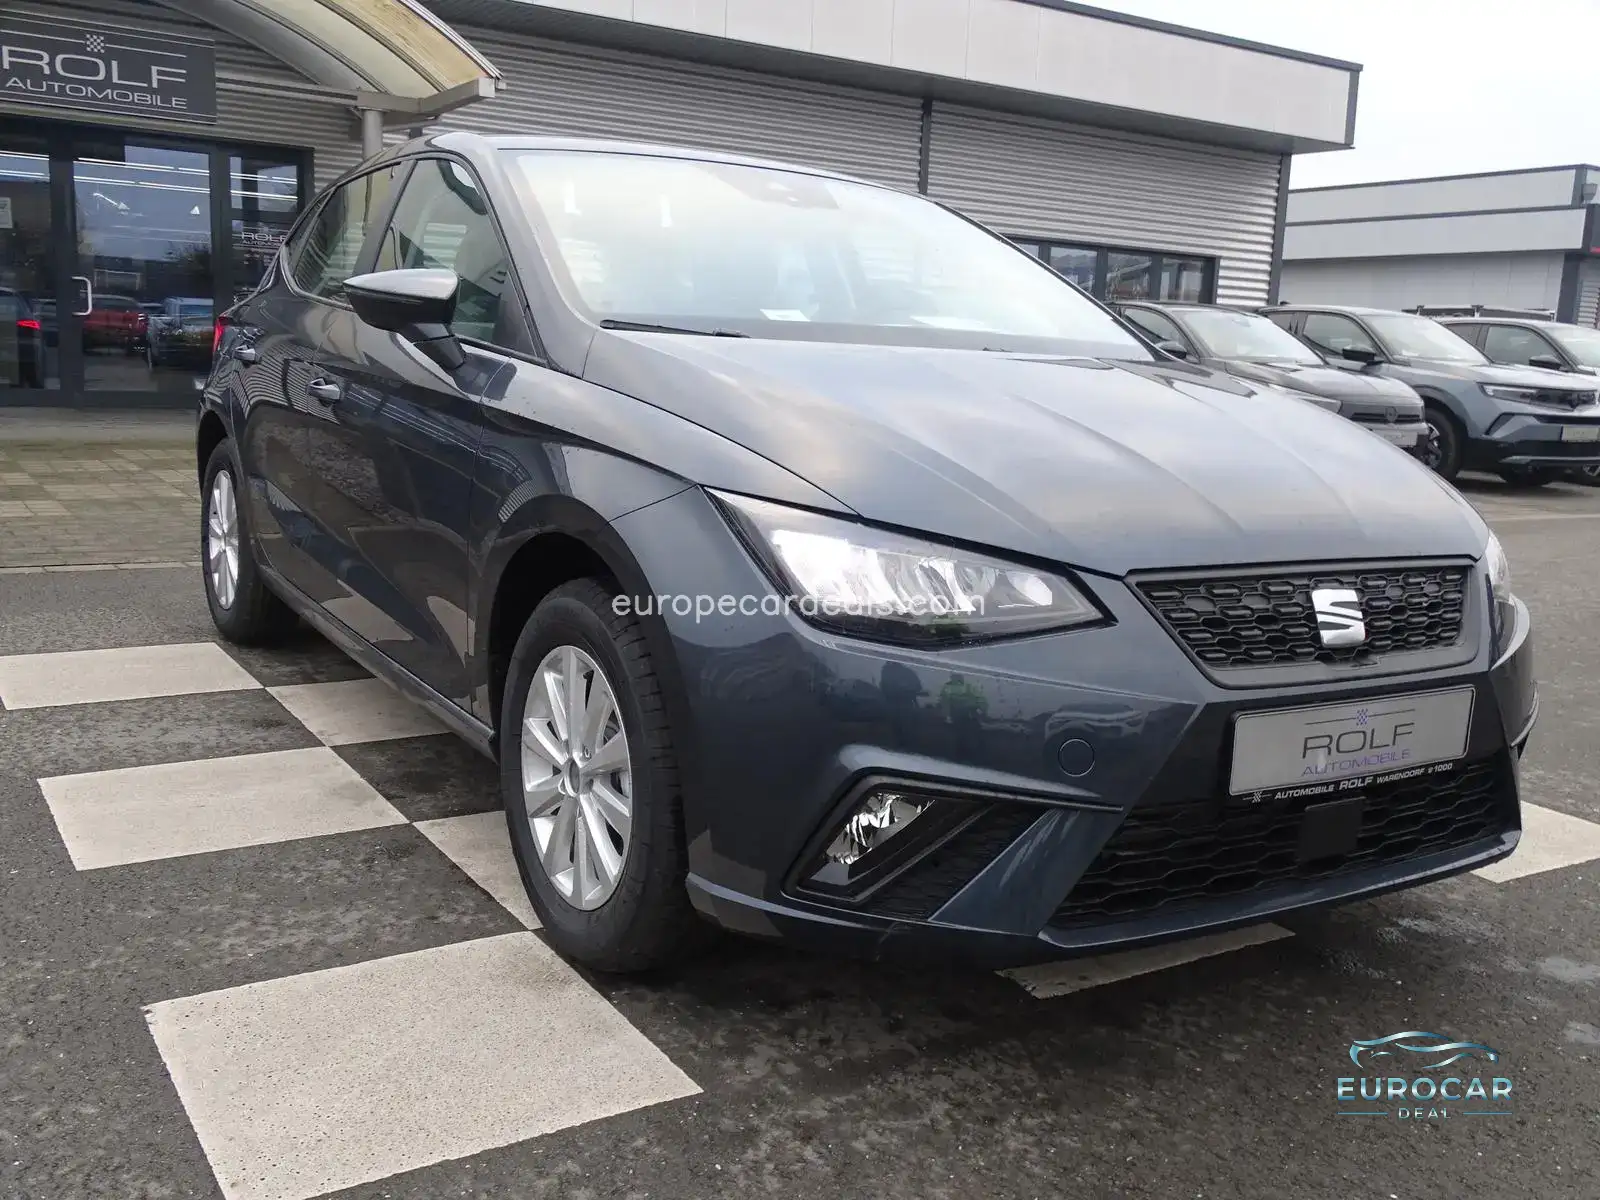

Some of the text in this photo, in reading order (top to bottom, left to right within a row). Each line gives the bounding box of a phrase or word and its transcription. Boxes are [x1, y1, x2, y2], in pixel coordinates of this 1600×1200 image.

[2, 45, 187, 88] ROLF
[5, 77, 187, 109] AUTOMOBILE
[1302, 722, 1415, 759] ROLF
[1301, 748, 1411, 777] AUTOMOBILE
[1274, 784, 1335, 800] AUTOMOBILE
[1339, 776, 1374, 791] ROLF
[1376, 767, 1425, 784] WARENDORF
